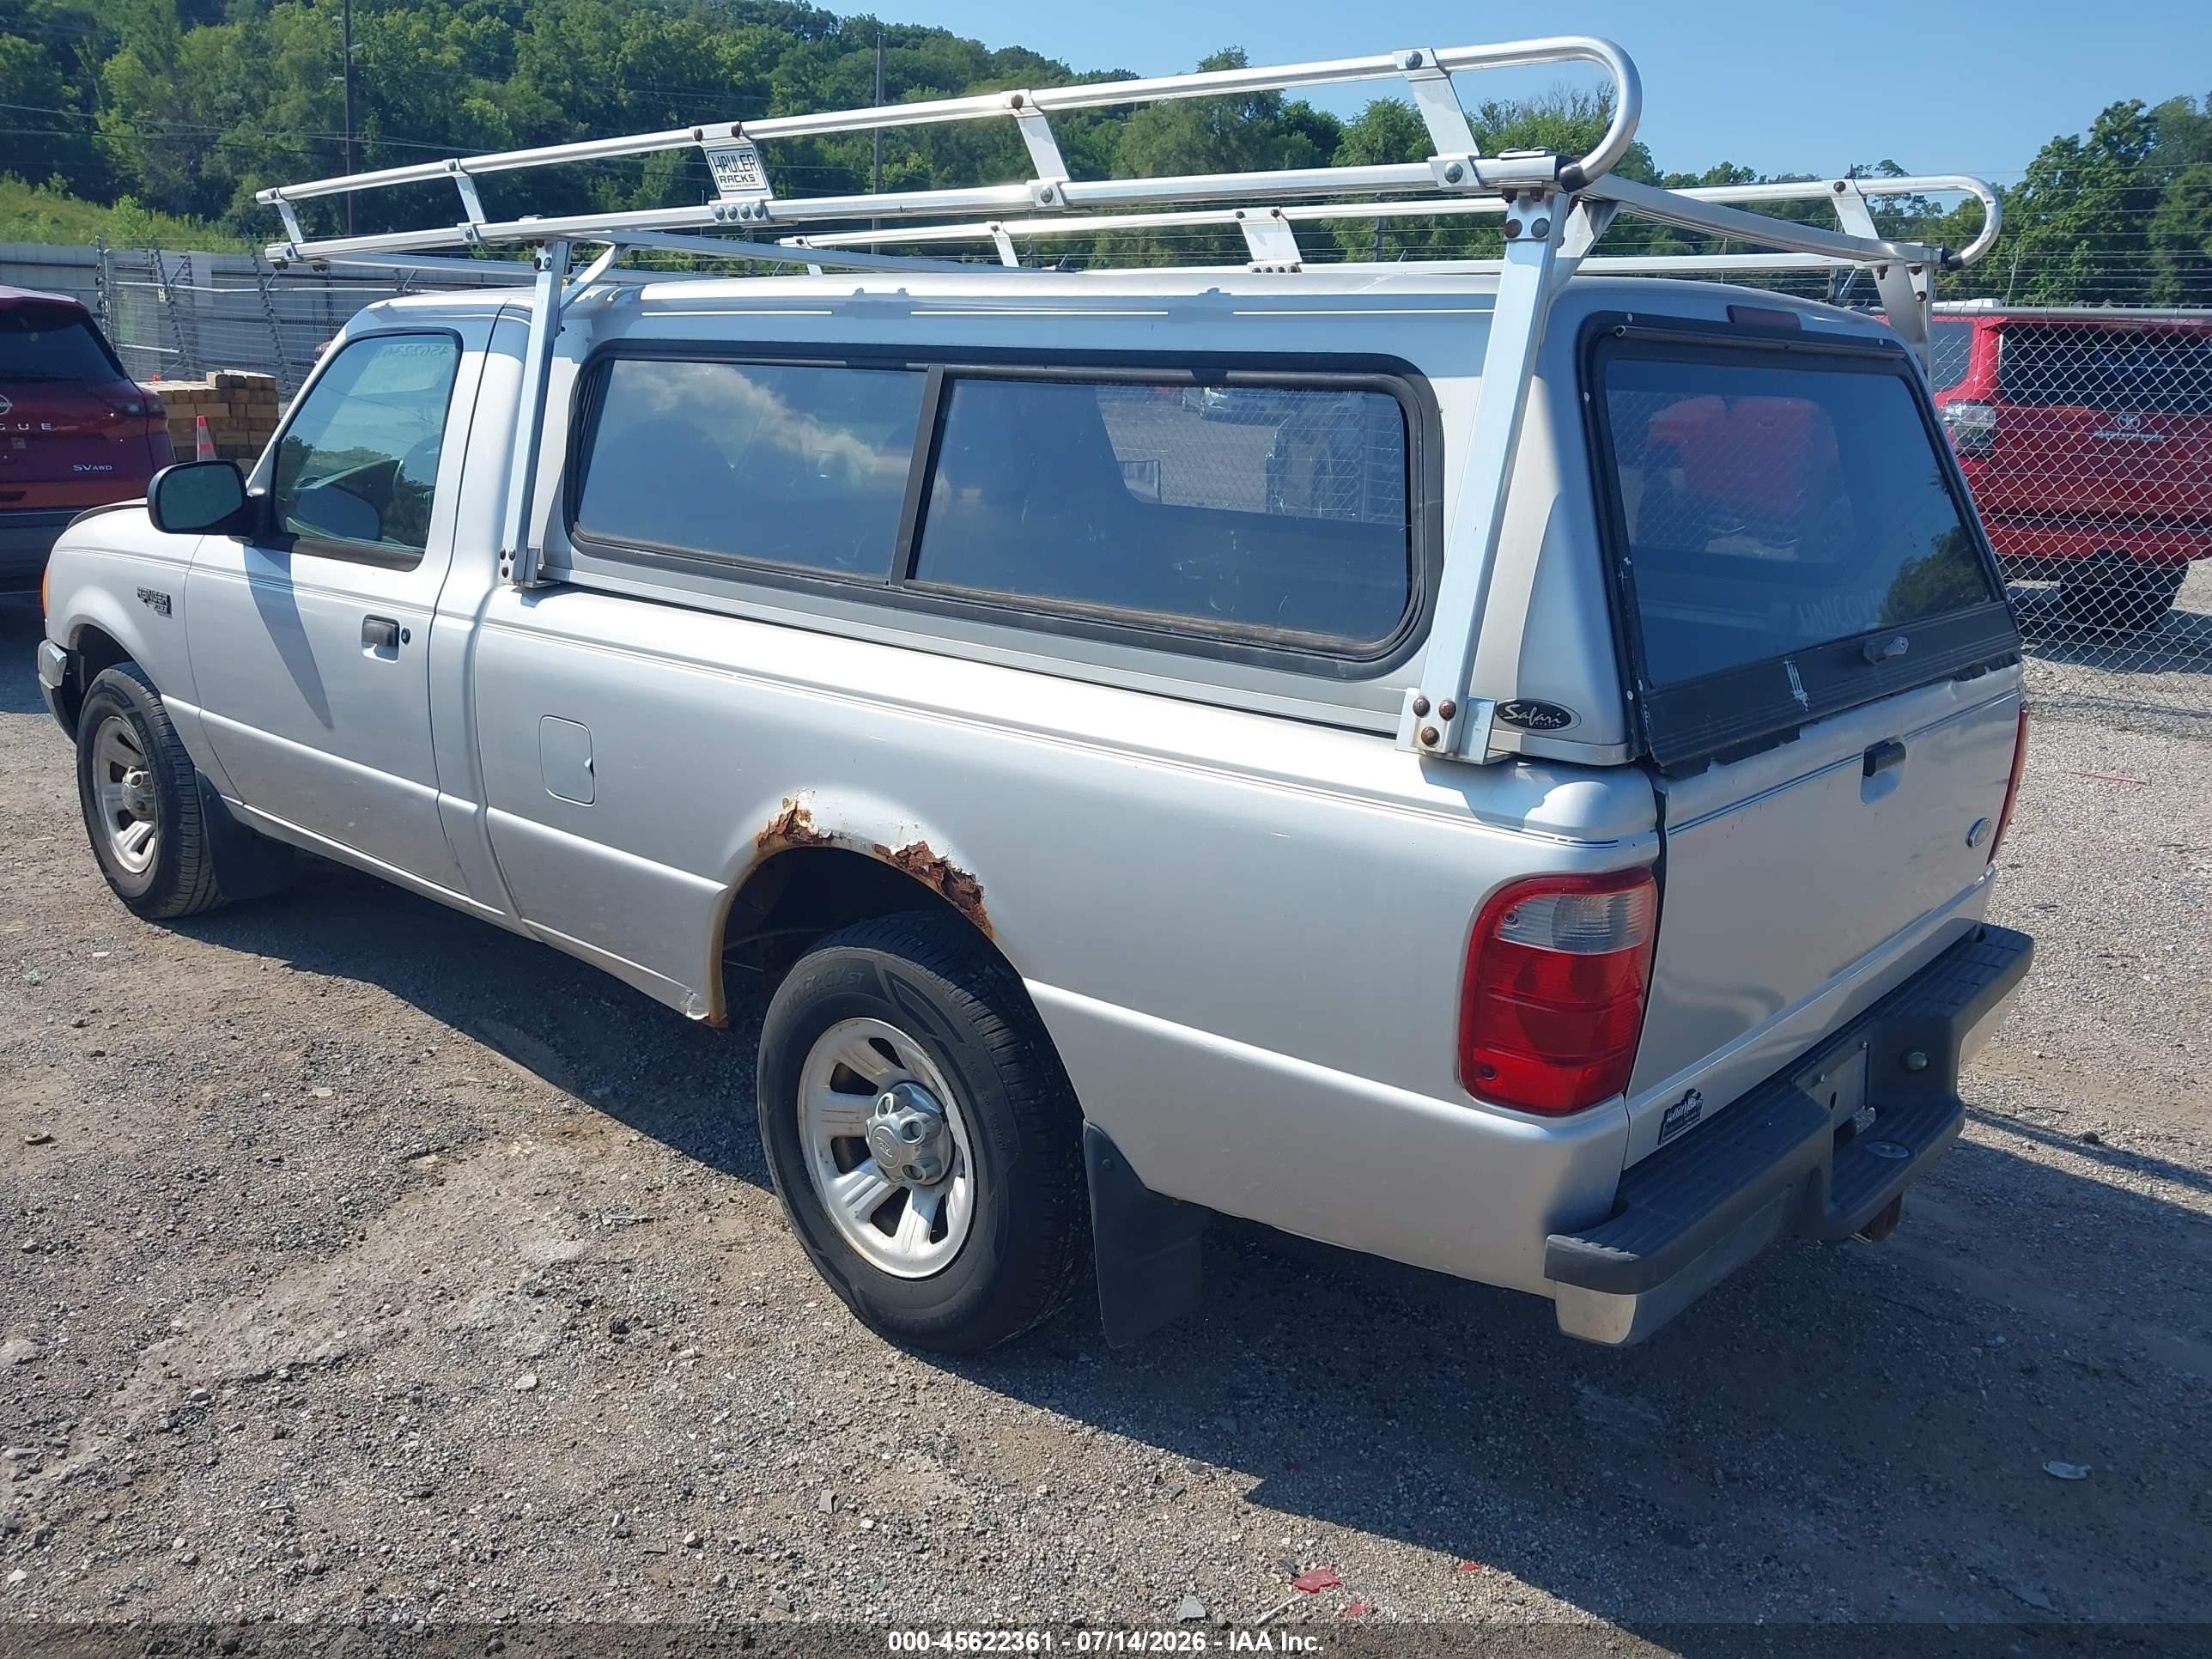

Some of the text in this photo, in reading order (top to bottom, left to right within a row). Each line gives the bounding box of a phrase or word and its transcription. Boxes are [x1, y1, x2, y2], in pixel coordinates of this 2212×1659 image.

[711, 154, 758, 174] HAULER
[719, 173, 756, 184] RACKS
[137, 586, 167, 605] RANGER
[1503, 704, 1562, 726] Safari
